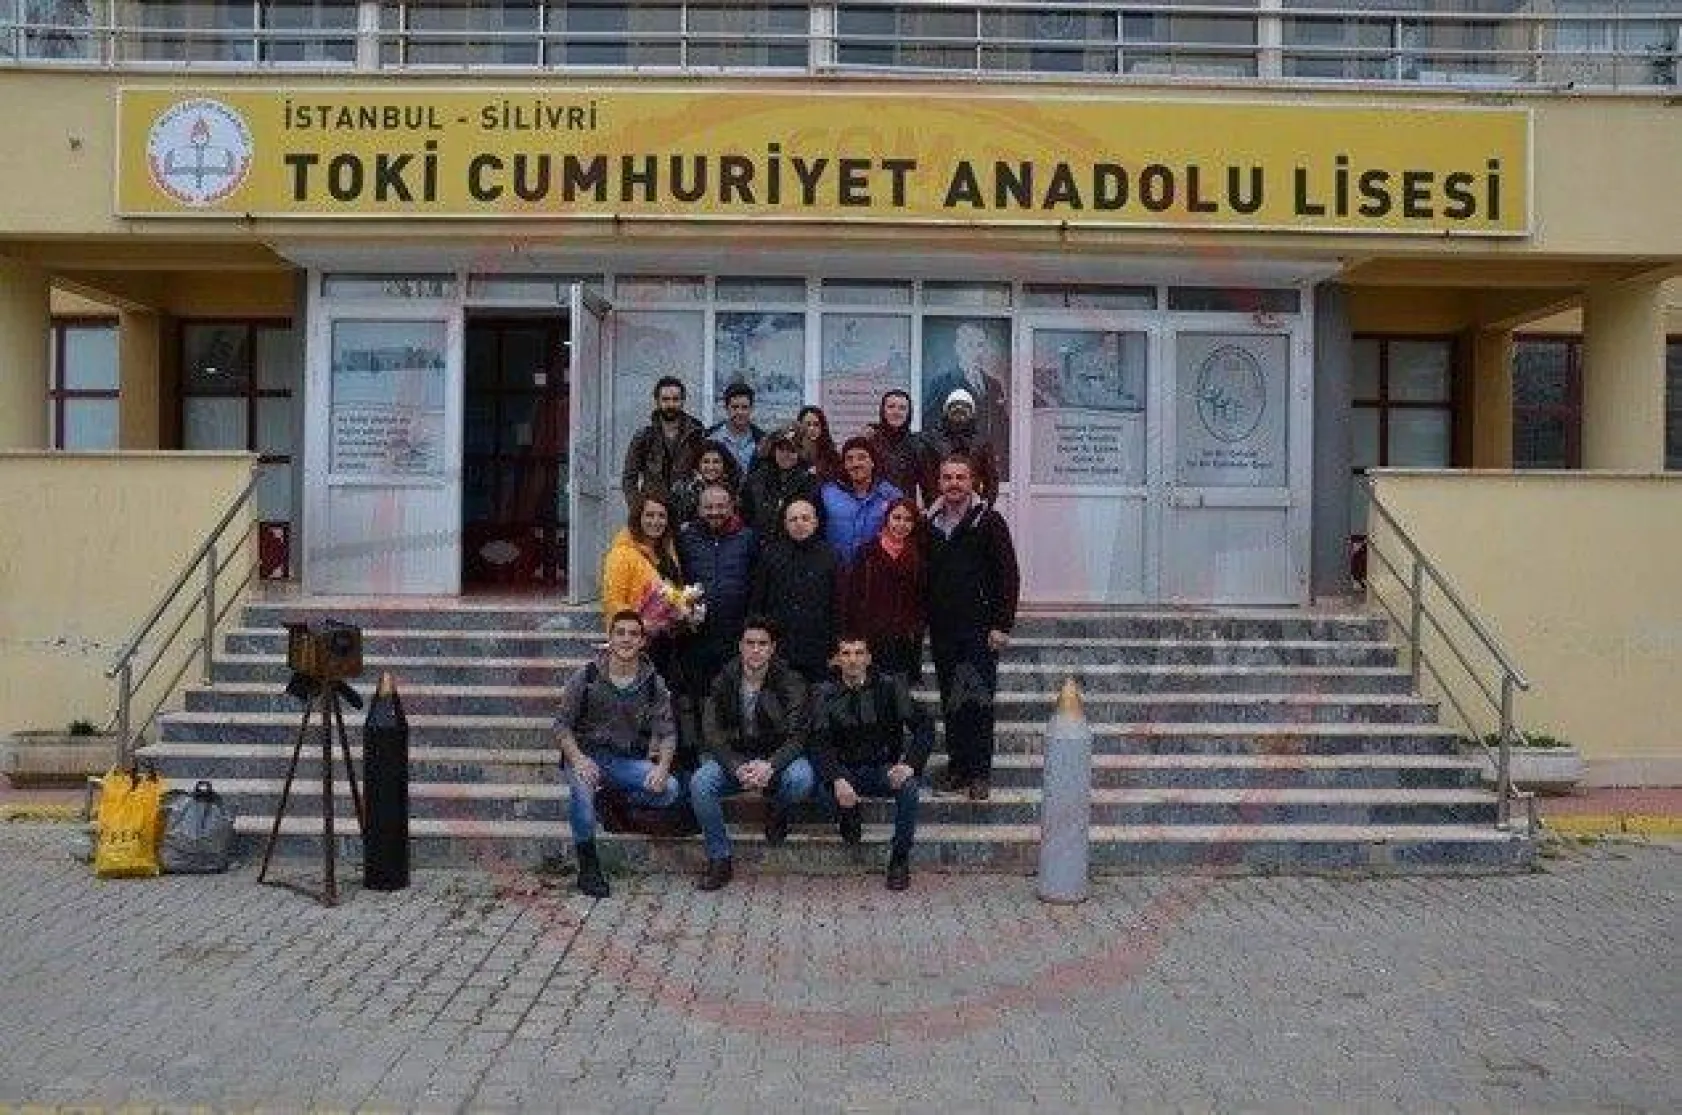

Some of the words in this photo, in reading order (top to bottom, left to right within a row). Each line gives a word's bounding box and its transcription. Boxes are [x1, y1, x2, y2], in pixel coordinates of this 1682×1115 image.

[285, 100, 443, 131] İSTANBUL
[481, 100, 598, 131] SİLİVRİ
[285, 141, 438, 202] TOKİ
[468, 143, 917, 207] CUMHURİYET
[942, 161, 1264, 214] ANADOLU
[1294, 155, 1500, 221] LİSESİ
